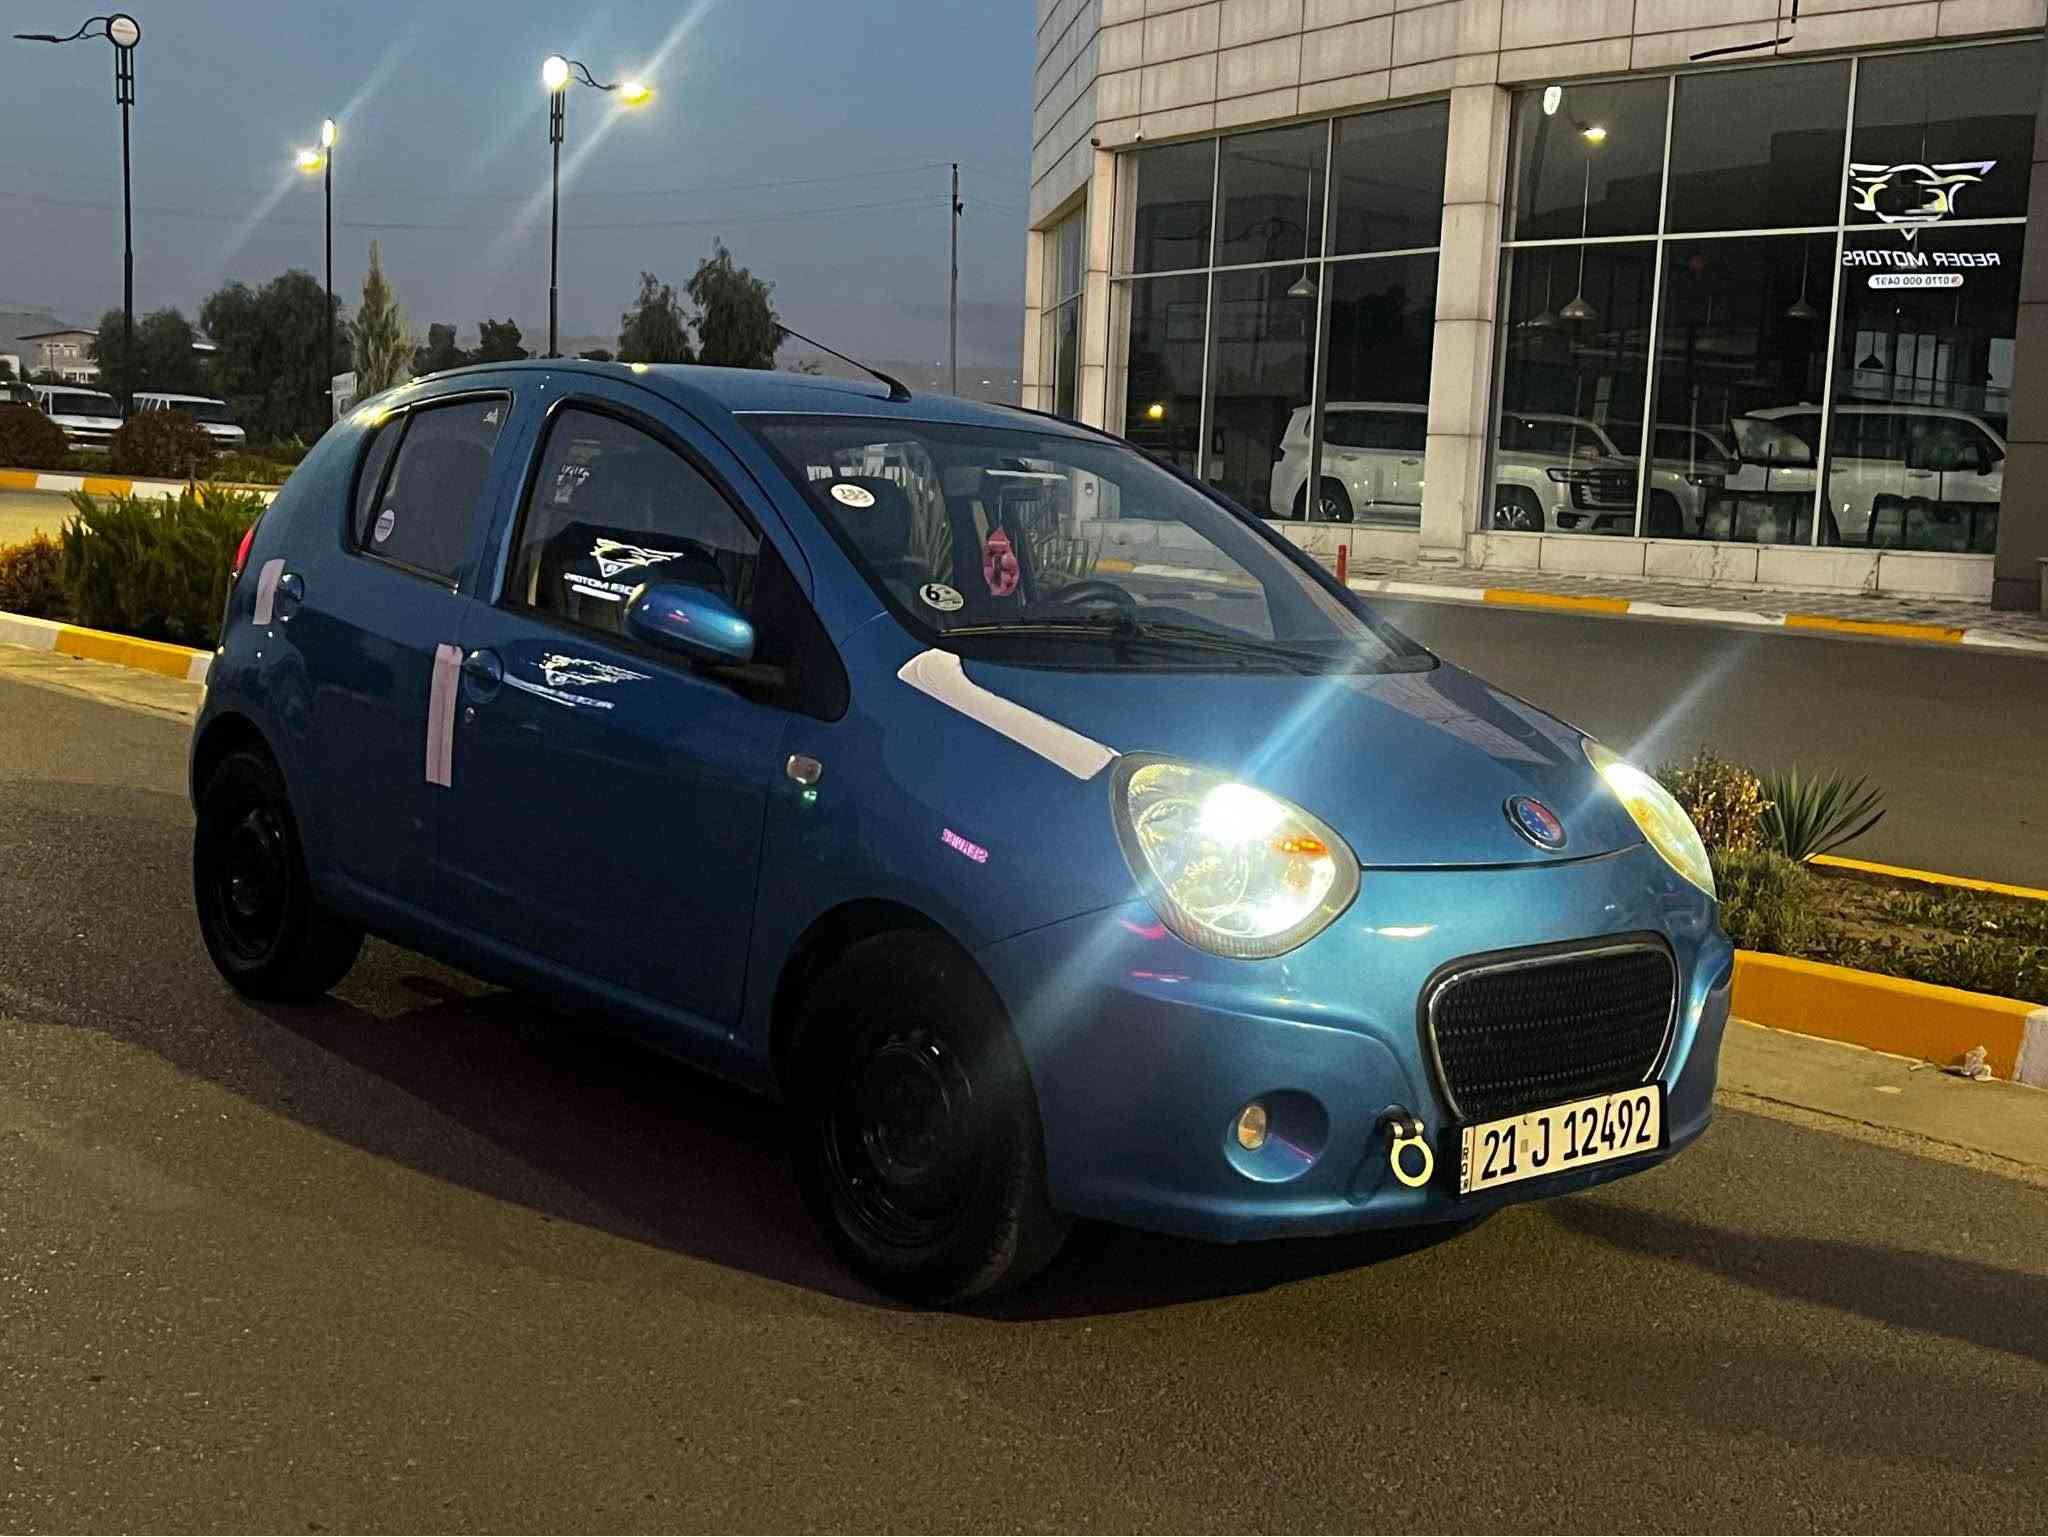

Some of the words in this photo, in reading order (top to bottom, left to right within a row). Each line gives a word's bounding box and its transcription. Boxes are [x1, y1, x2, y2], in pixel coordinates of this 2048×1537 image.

[1480, 1125, 1517, 1181] 21
[1531, 1117, 1551, 1168] J
[1563, 1095, 1651, 1161] 12492
